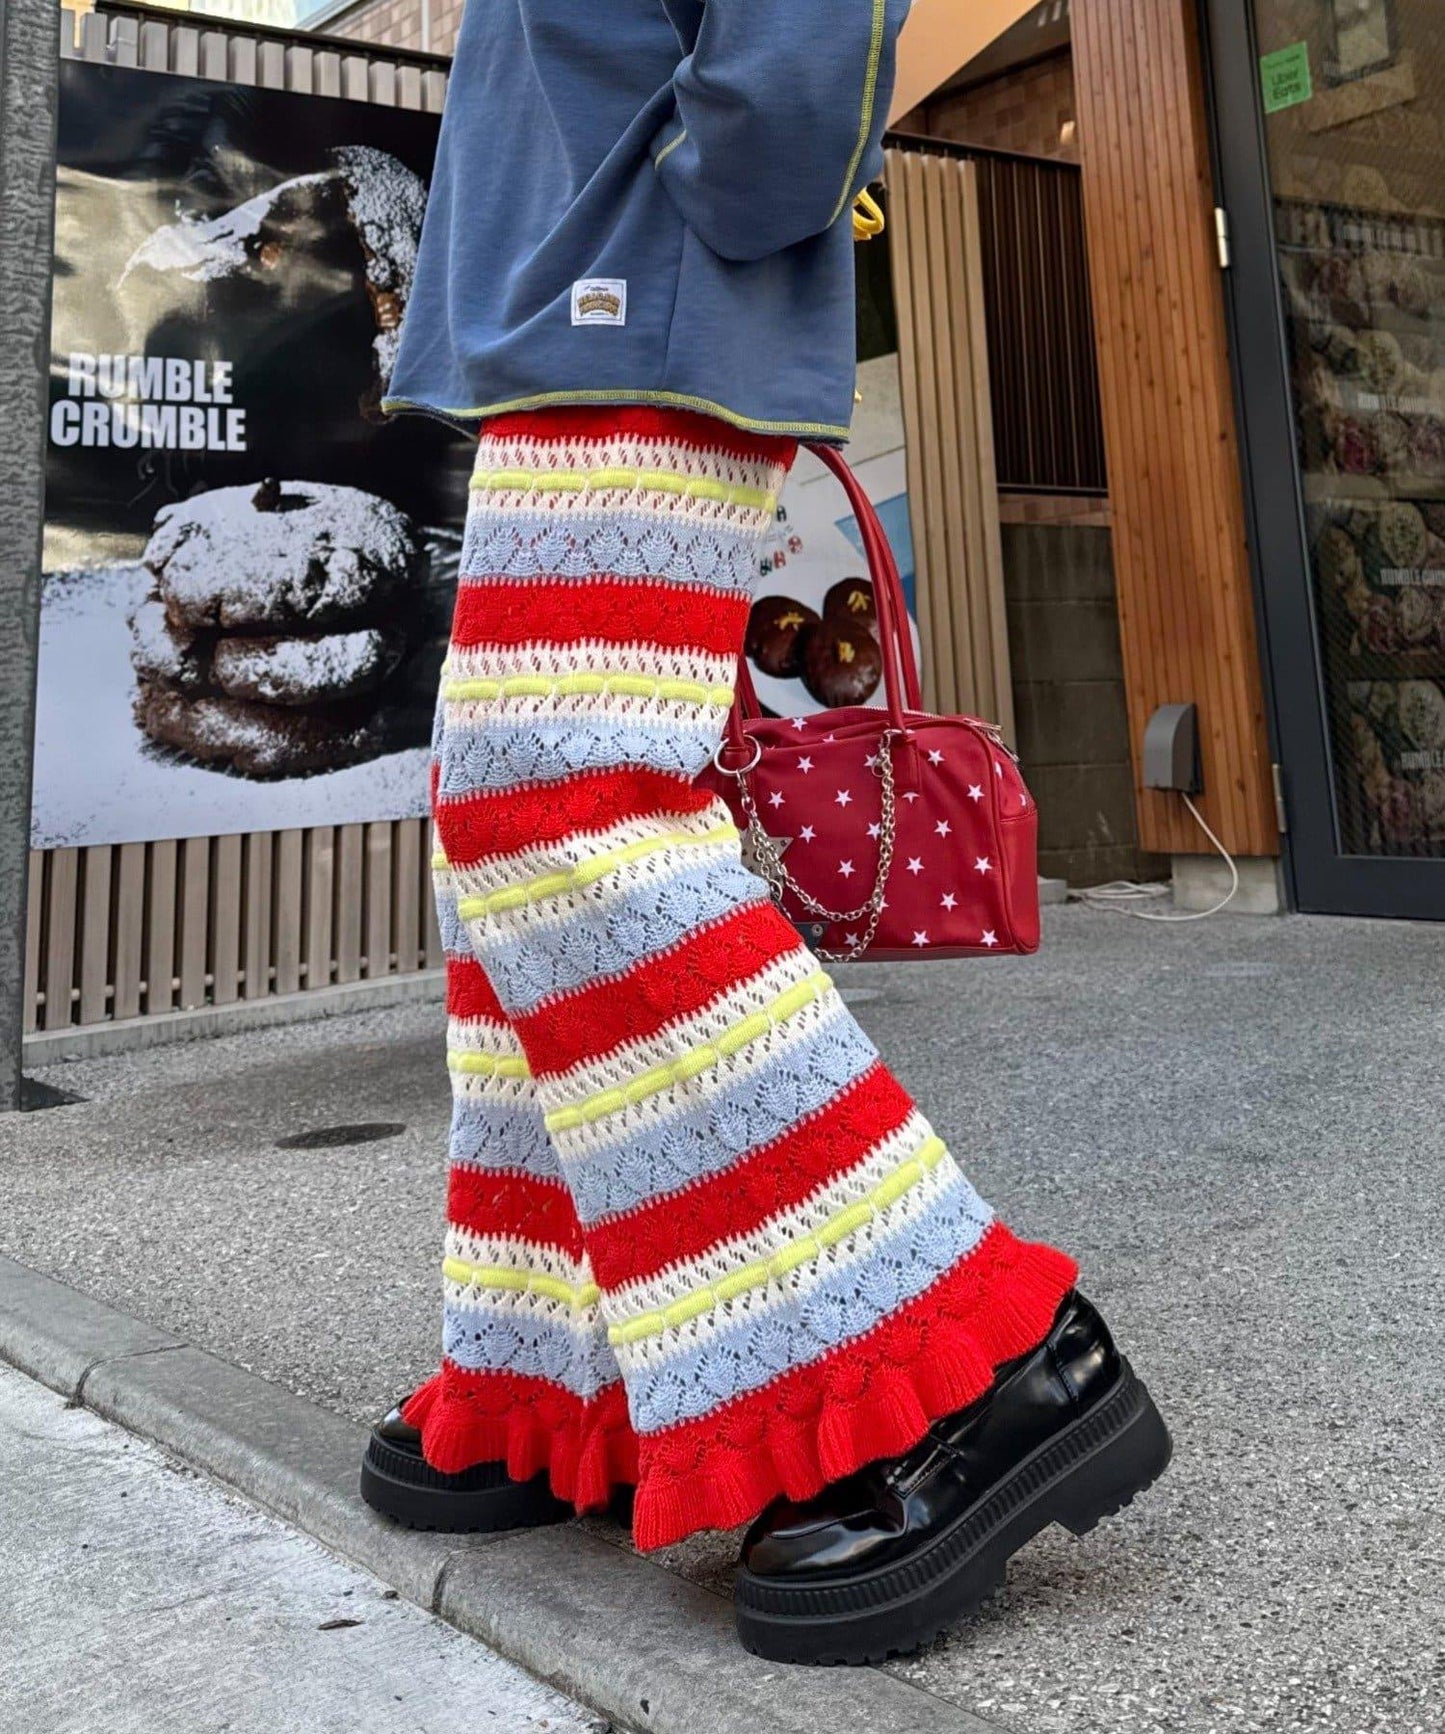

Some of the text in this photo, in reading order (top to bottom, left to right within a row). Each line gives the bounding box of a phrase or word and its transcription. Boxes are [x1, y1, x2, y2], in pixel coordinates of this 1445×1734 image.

[1271, 68, 1299, 86] Uber
[1272, 83, 1301, 100] Eats
[68, 352, 233, 403] RUMBLE
[51, 399, 247, 451] CRUMBLE
